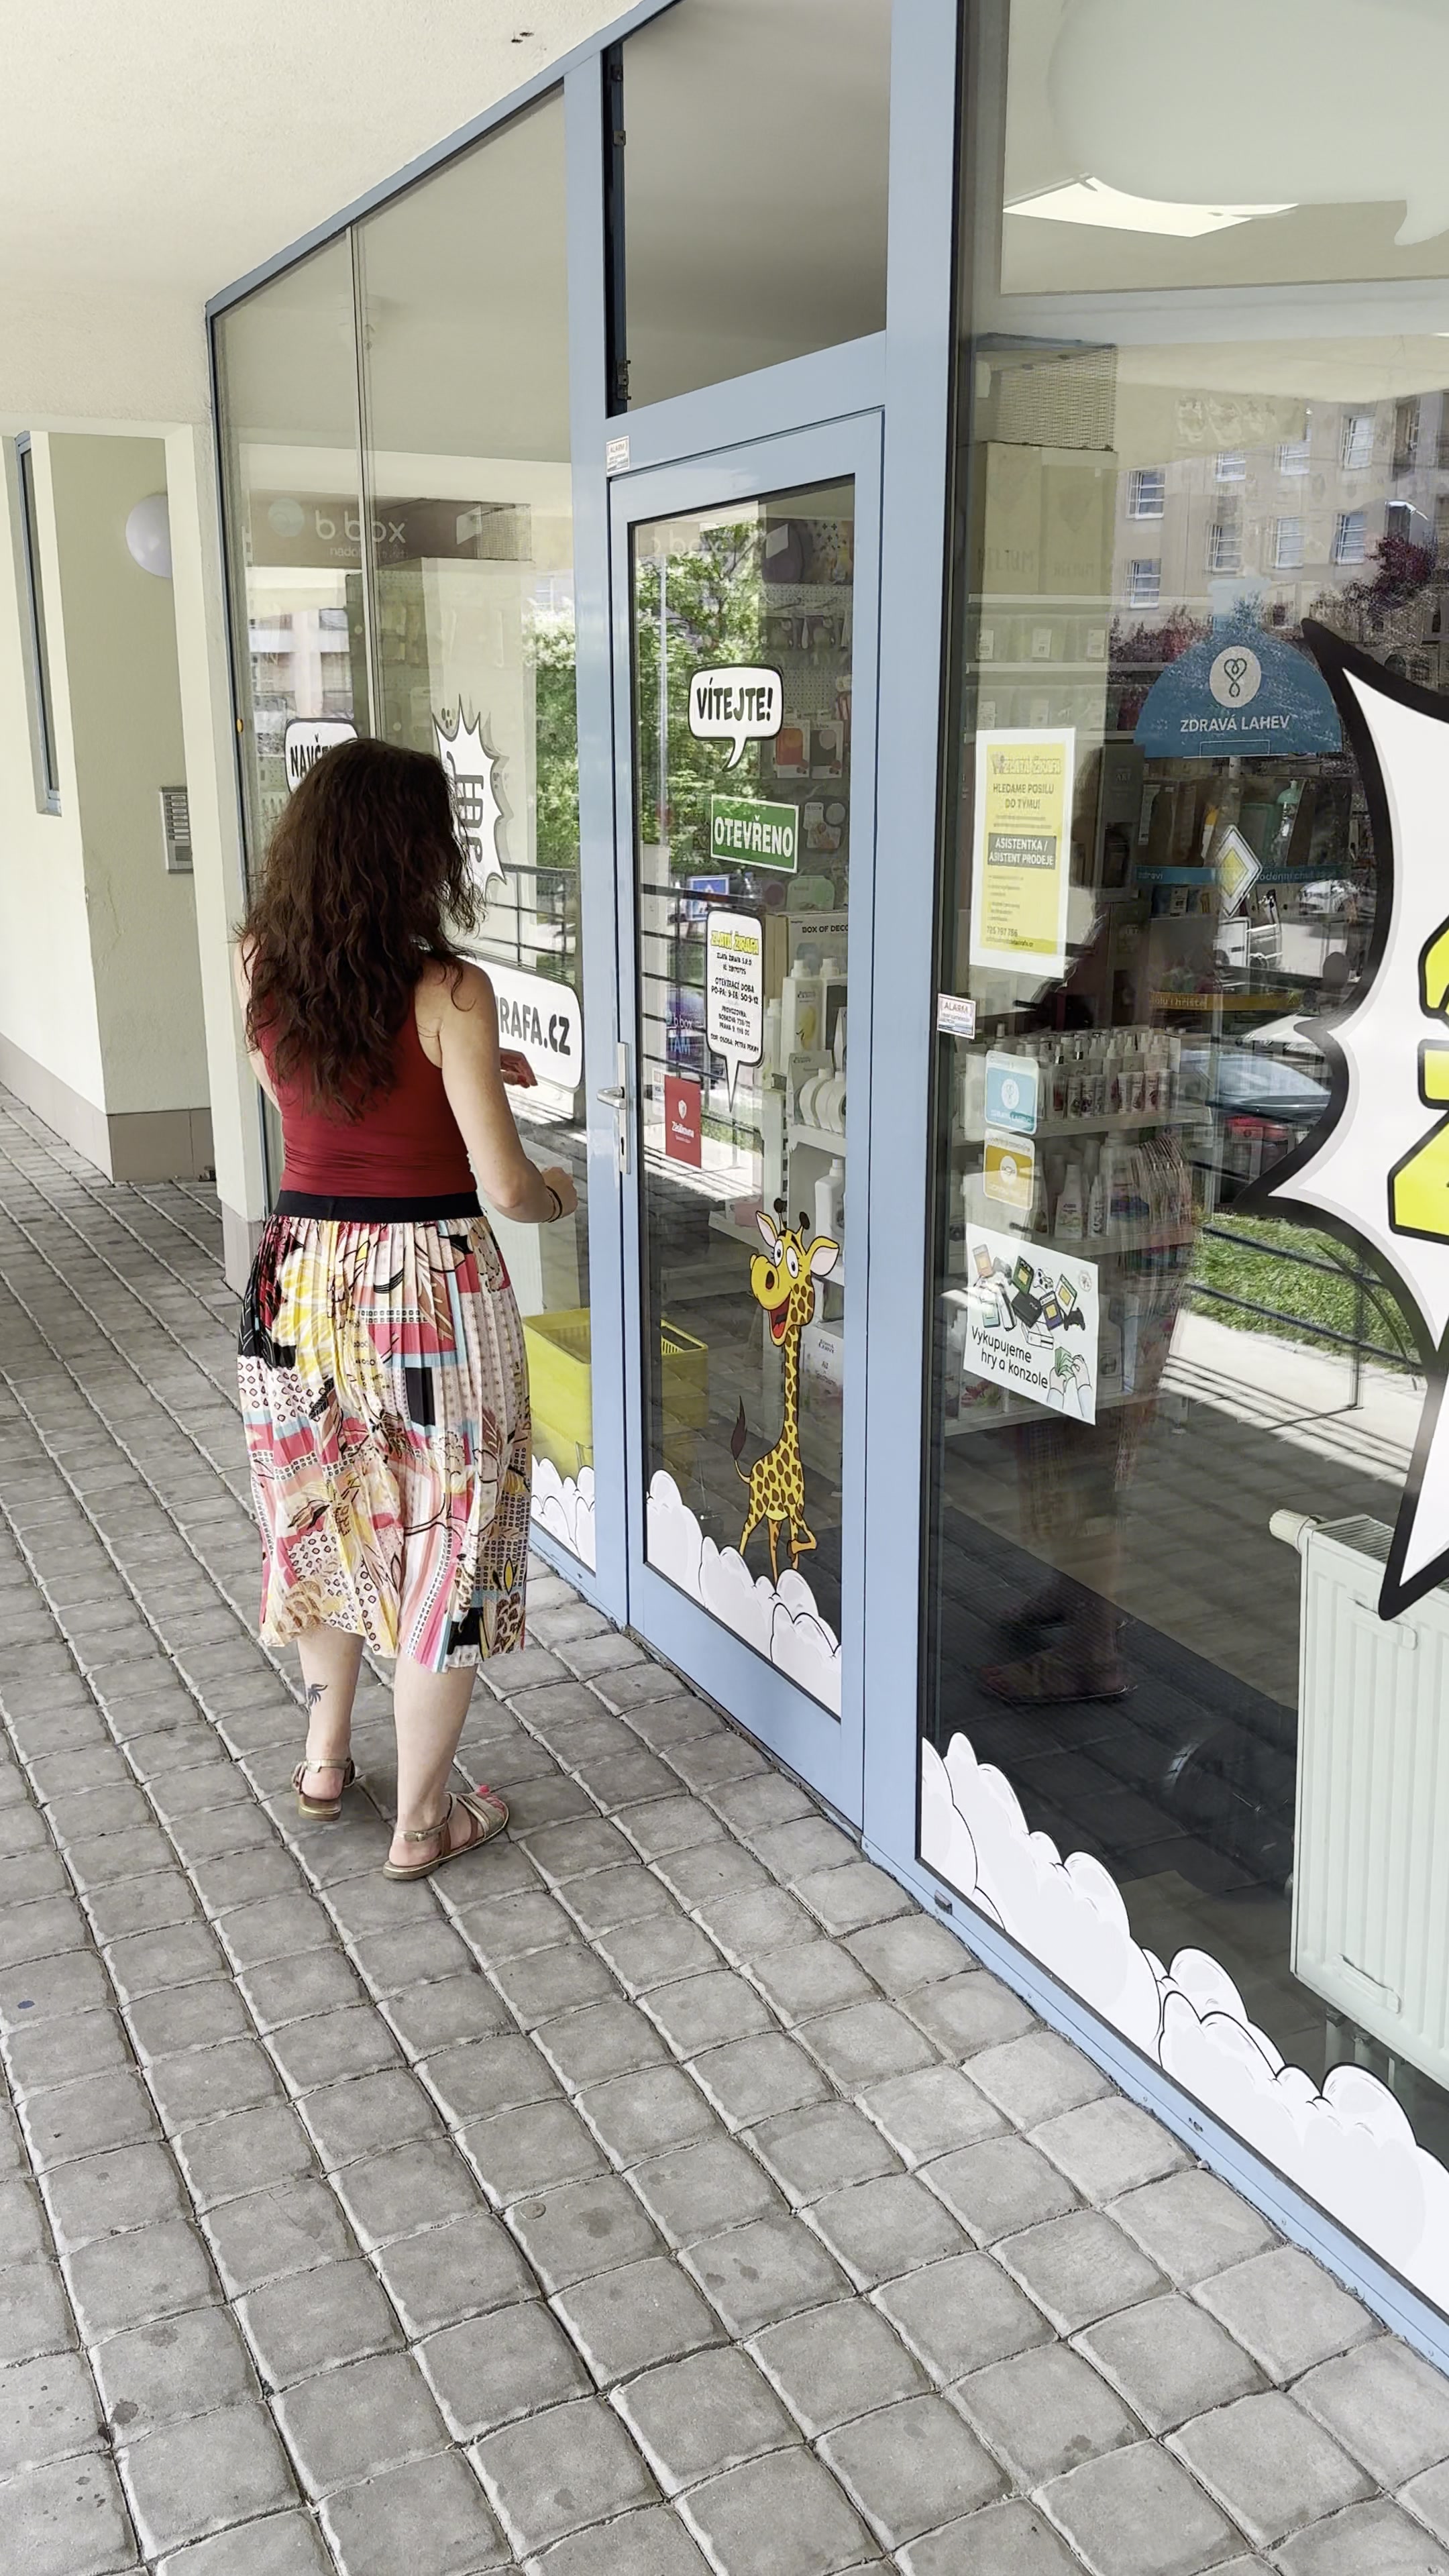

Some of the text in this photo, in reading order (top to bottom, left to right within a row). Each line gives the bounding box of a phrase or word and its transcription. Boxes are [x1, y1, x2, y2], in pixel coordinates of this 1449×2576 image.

[696, 677, 773, 721] VÍTEJTE!
[1180, 714, 1290, 733] ZDRAVÁ LAHEV
[714, 814, 793, 857] OTEVŘENO
[996, 837, 1042, 851] ASISTENTKA
[989, 851, 1054, 865] ASISTENT PRODEJE
[741, 983, 755, 993] DOBA
[971, 1326, 1032, 1363] Vykupujeme
[981, 1348, 1049, 1389] hry a konzole
